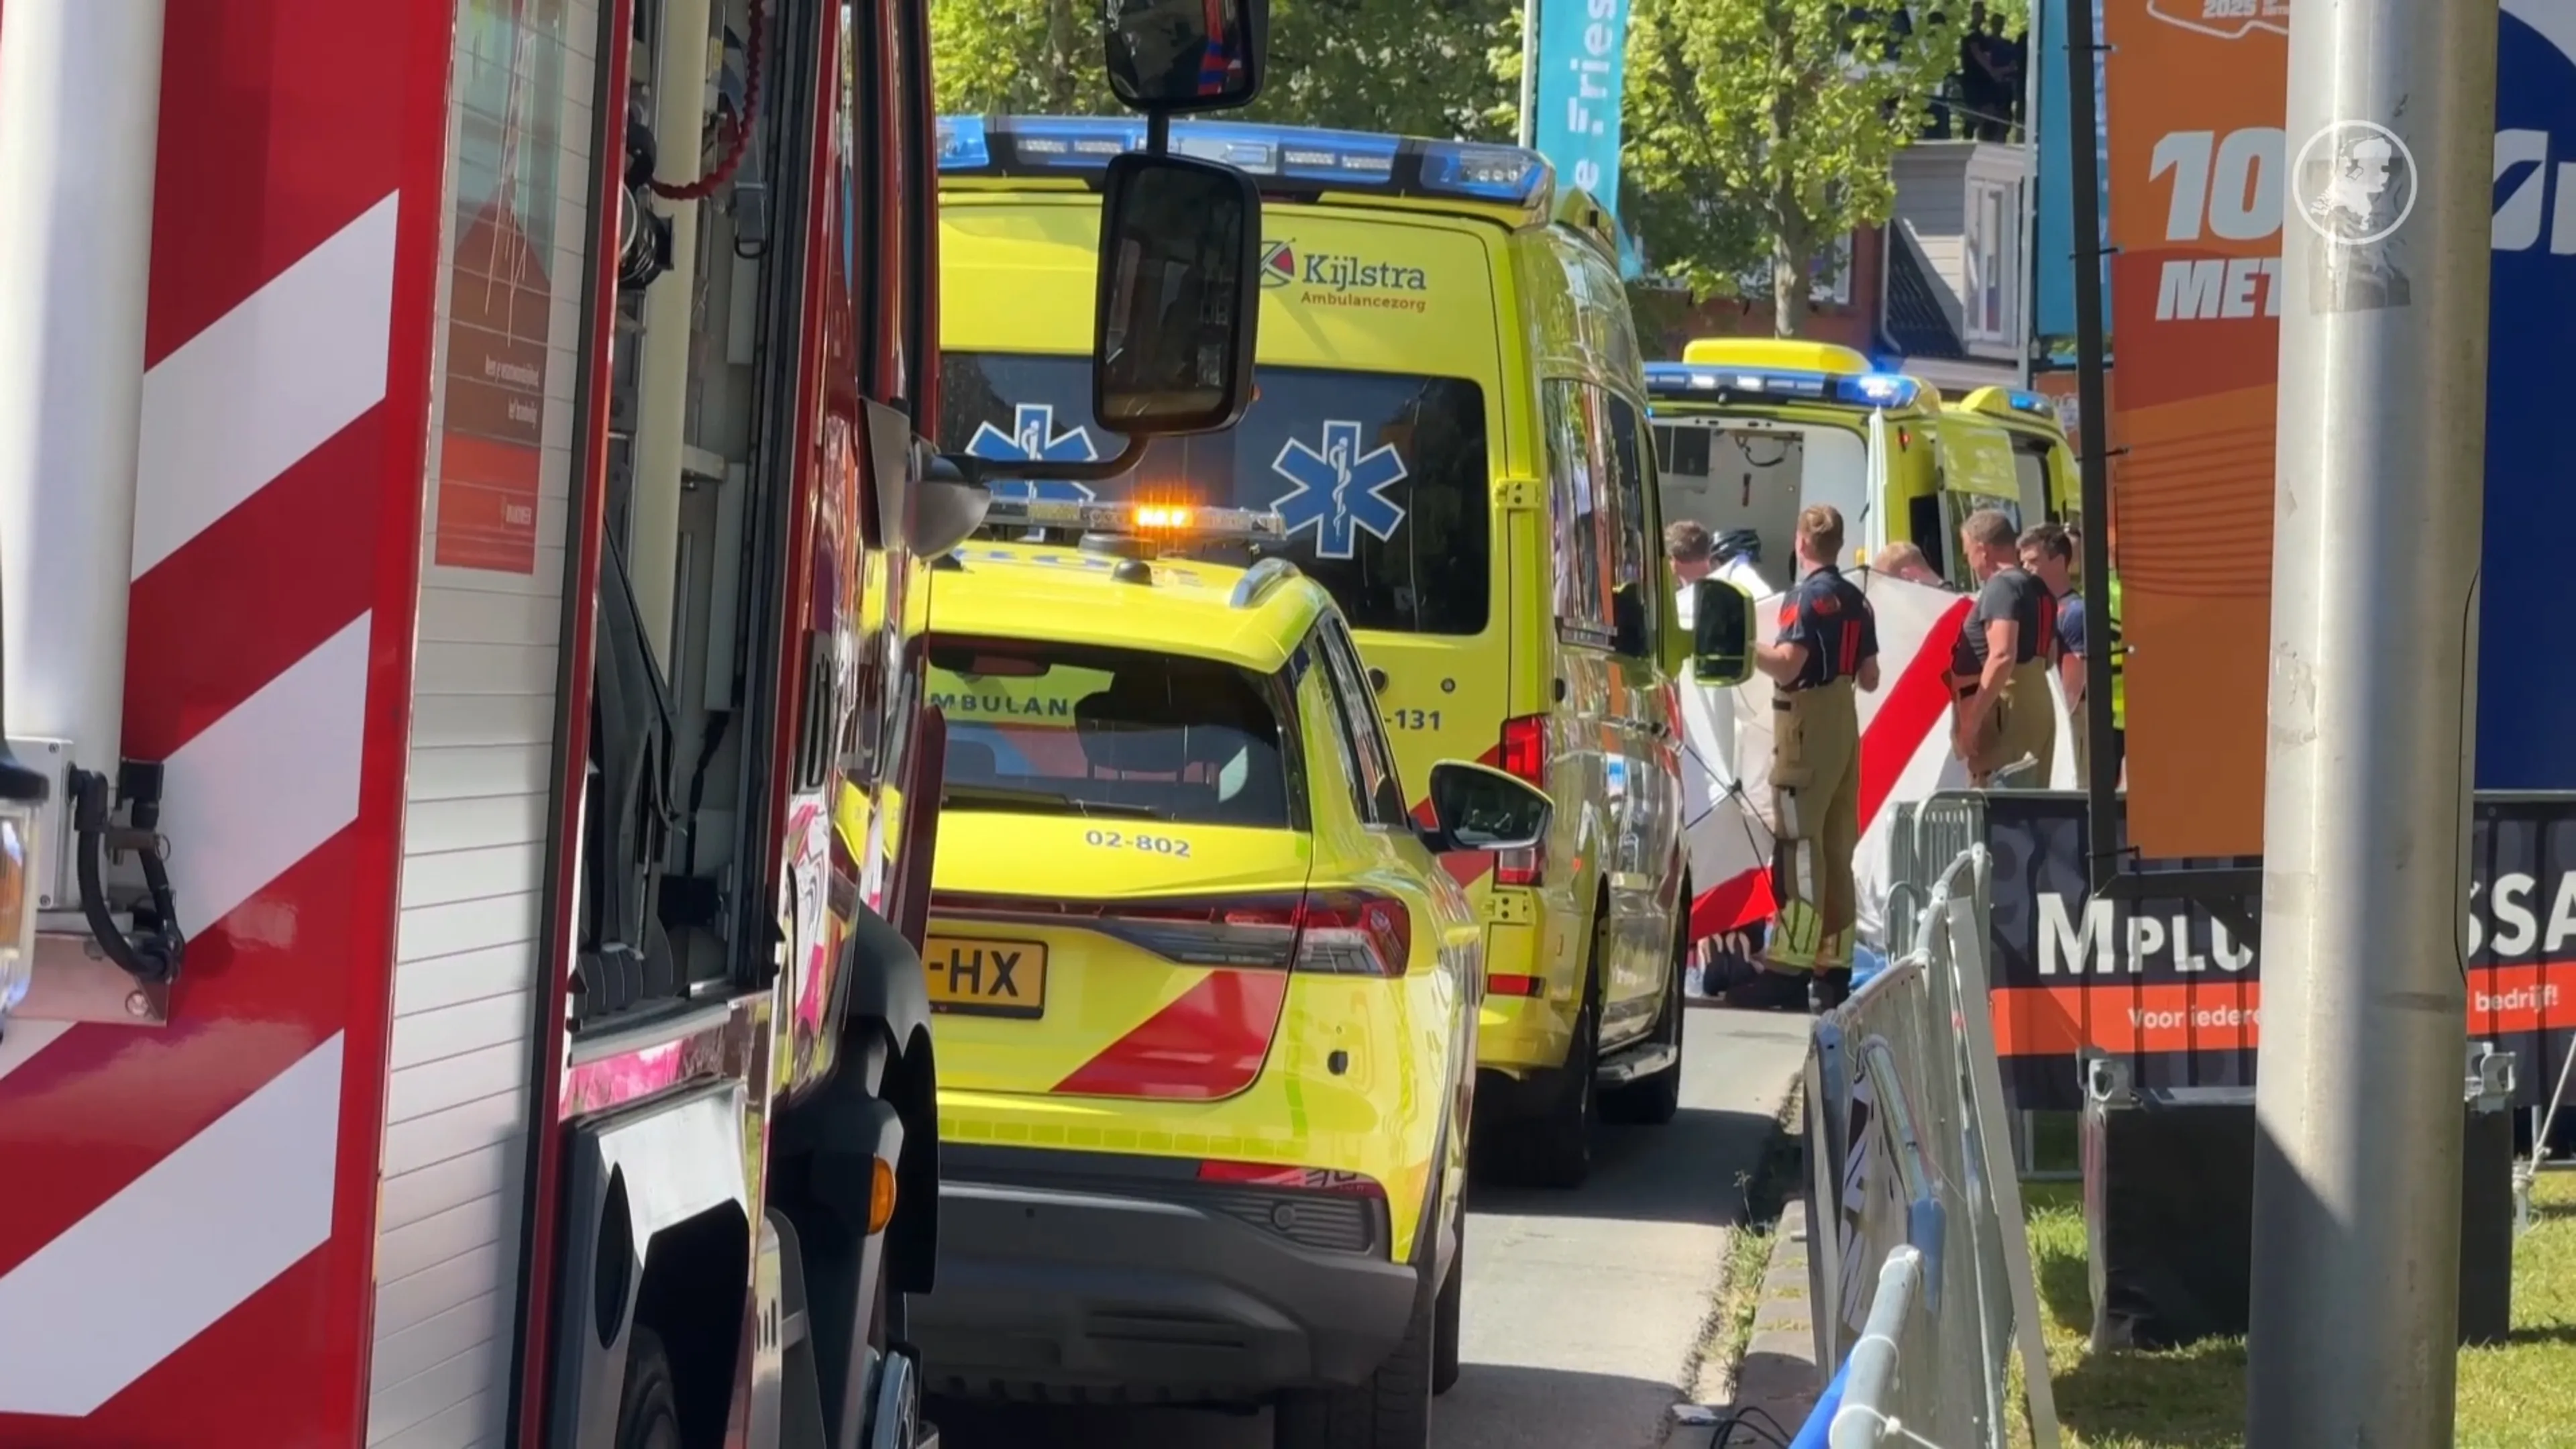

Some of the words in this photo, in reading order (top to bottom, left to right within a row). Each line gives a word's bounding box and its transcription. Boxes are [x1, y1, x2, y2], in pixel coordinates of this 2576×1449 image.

[1302, 254, 1427, 292] Kijlstra
[1300, 290, 1427, 313] Ambulancezorg
[1384, 708, 1440, 731] -131
[1085, 829, 1191, 858] 02-802
[929, 947, 1022, 998] -HX
[2128, 1006, 2183, 1030] Voor
[2475, 984, 2558, 1014] bedrijf!
